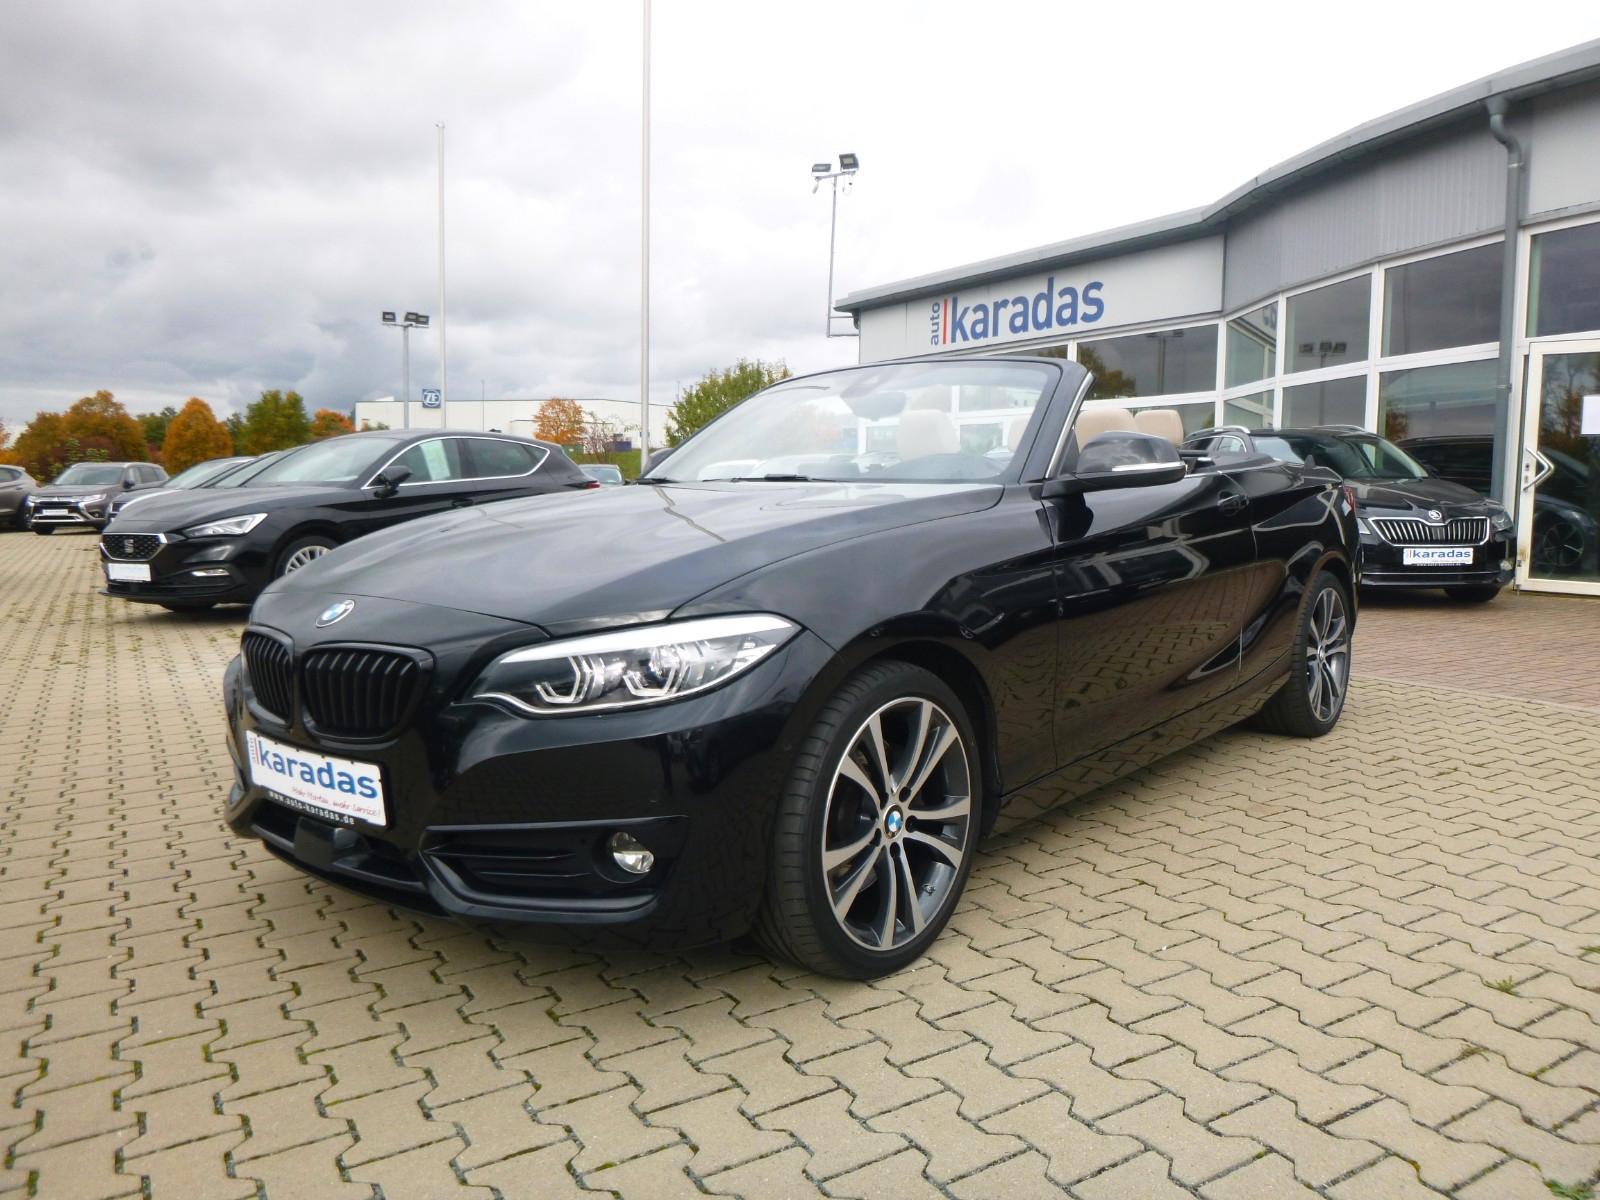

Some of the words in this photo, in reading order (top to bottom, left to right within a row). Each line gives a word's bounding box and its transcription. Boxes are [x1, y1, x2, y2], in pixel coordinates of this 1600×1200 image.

[930, 302, 941, 346] auto
[950, 276, 1105, 344] karadas
[1413, 549, 1471, 558] karadas
[258, 740, 378, 799] karadas
